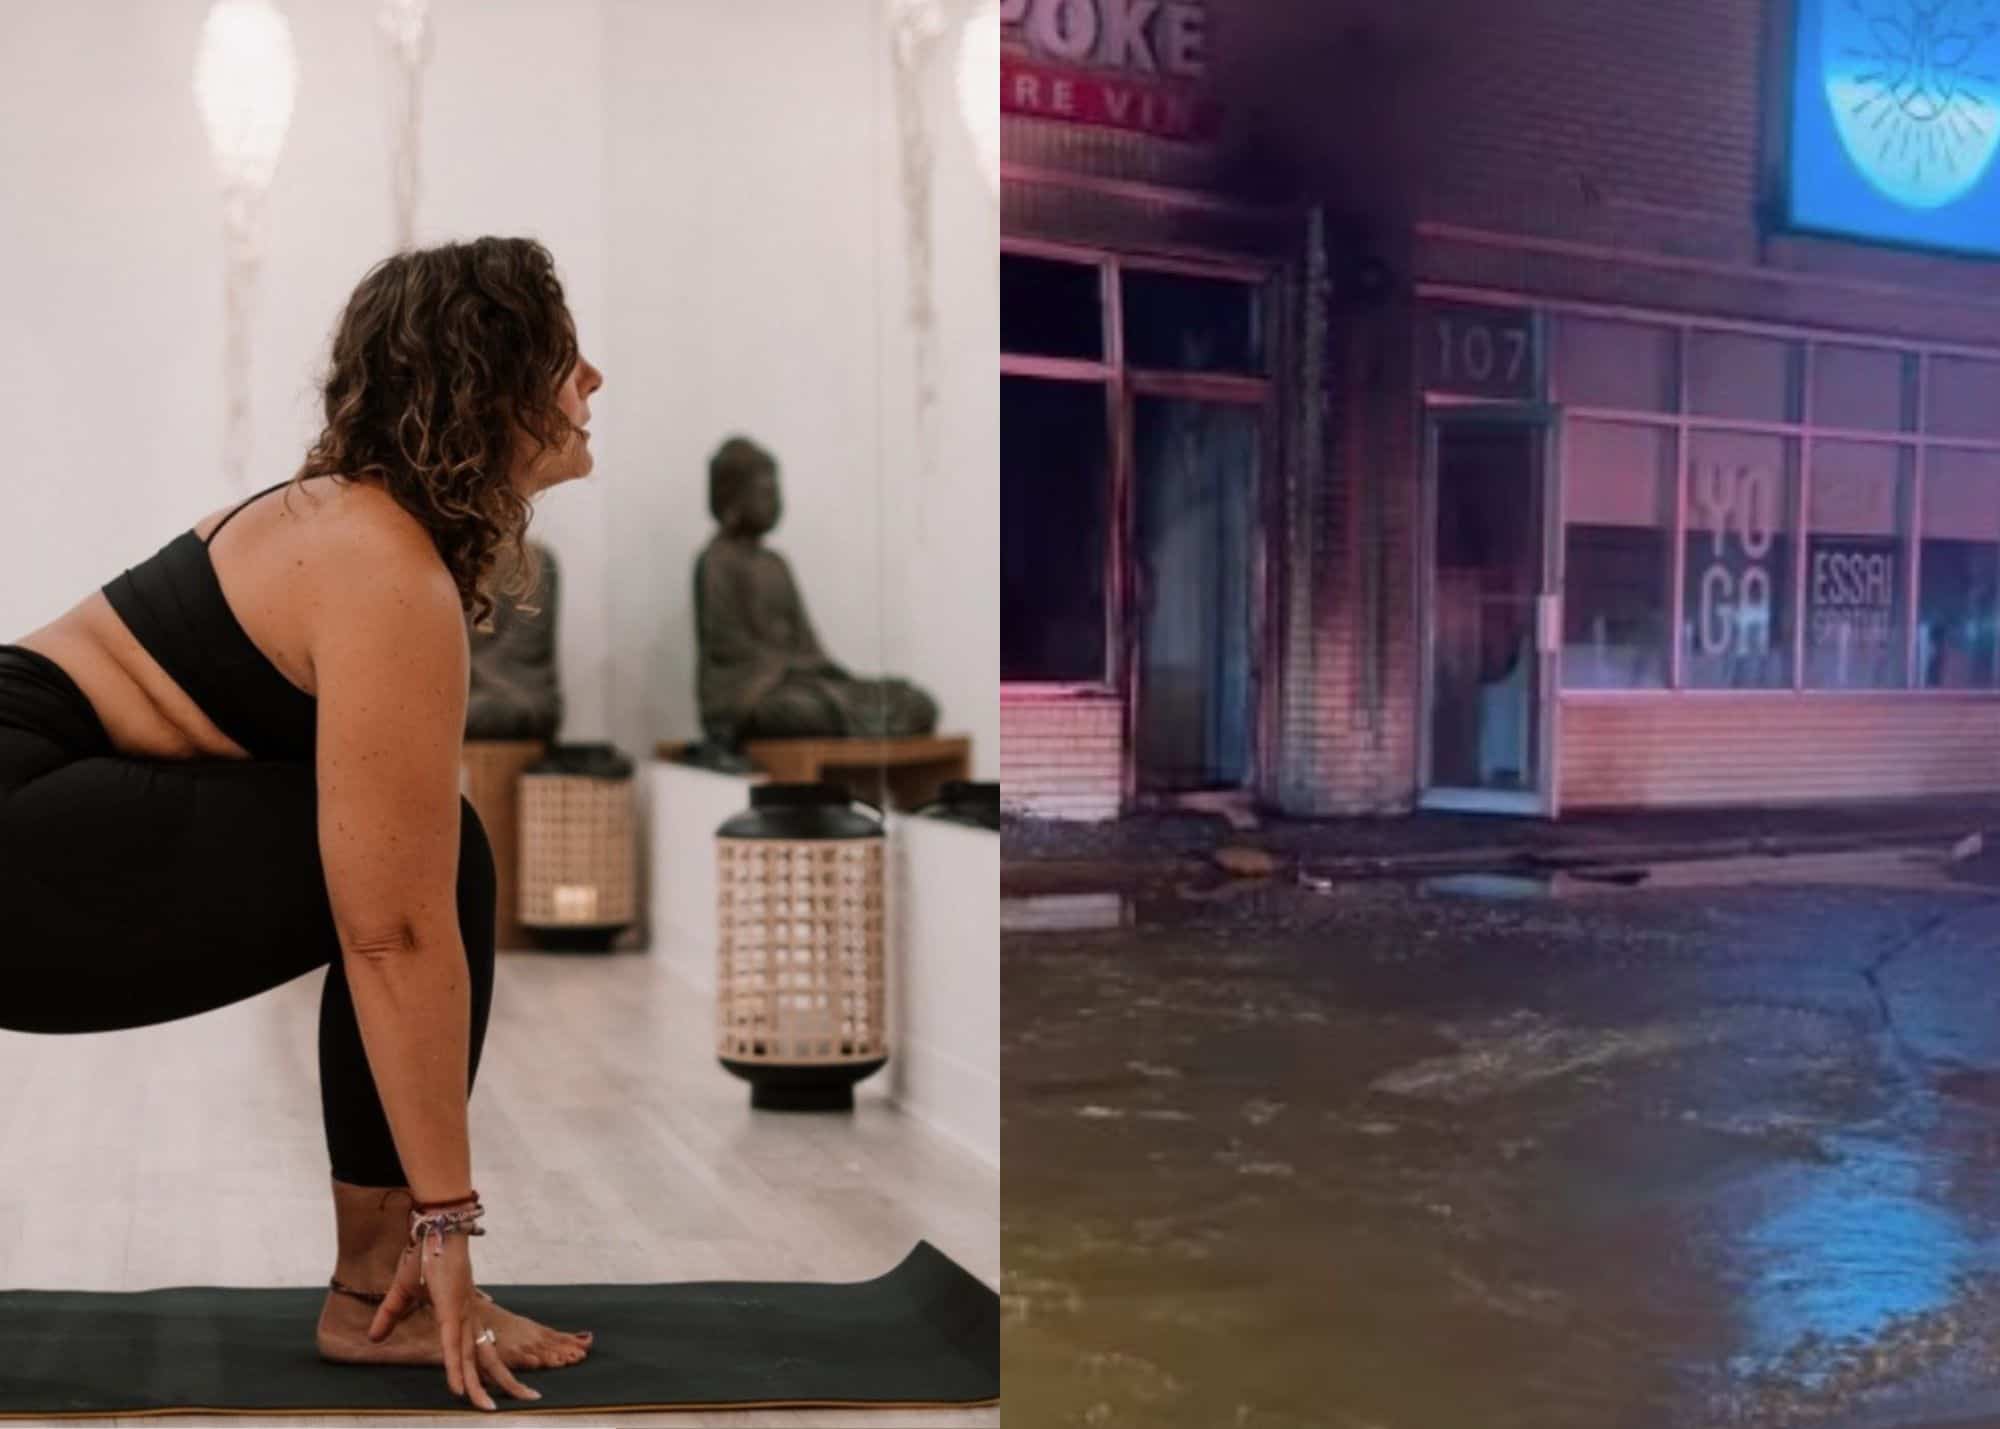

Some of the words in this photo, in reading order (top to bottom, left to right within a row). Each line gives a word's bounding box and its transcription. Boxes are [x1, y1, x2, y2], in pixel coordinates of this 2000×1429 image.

[1436, 319, 1527, 383] 107
[1702, 564, 1771, 655] GA
[1813, 551, 1893, 604] ESSAI
